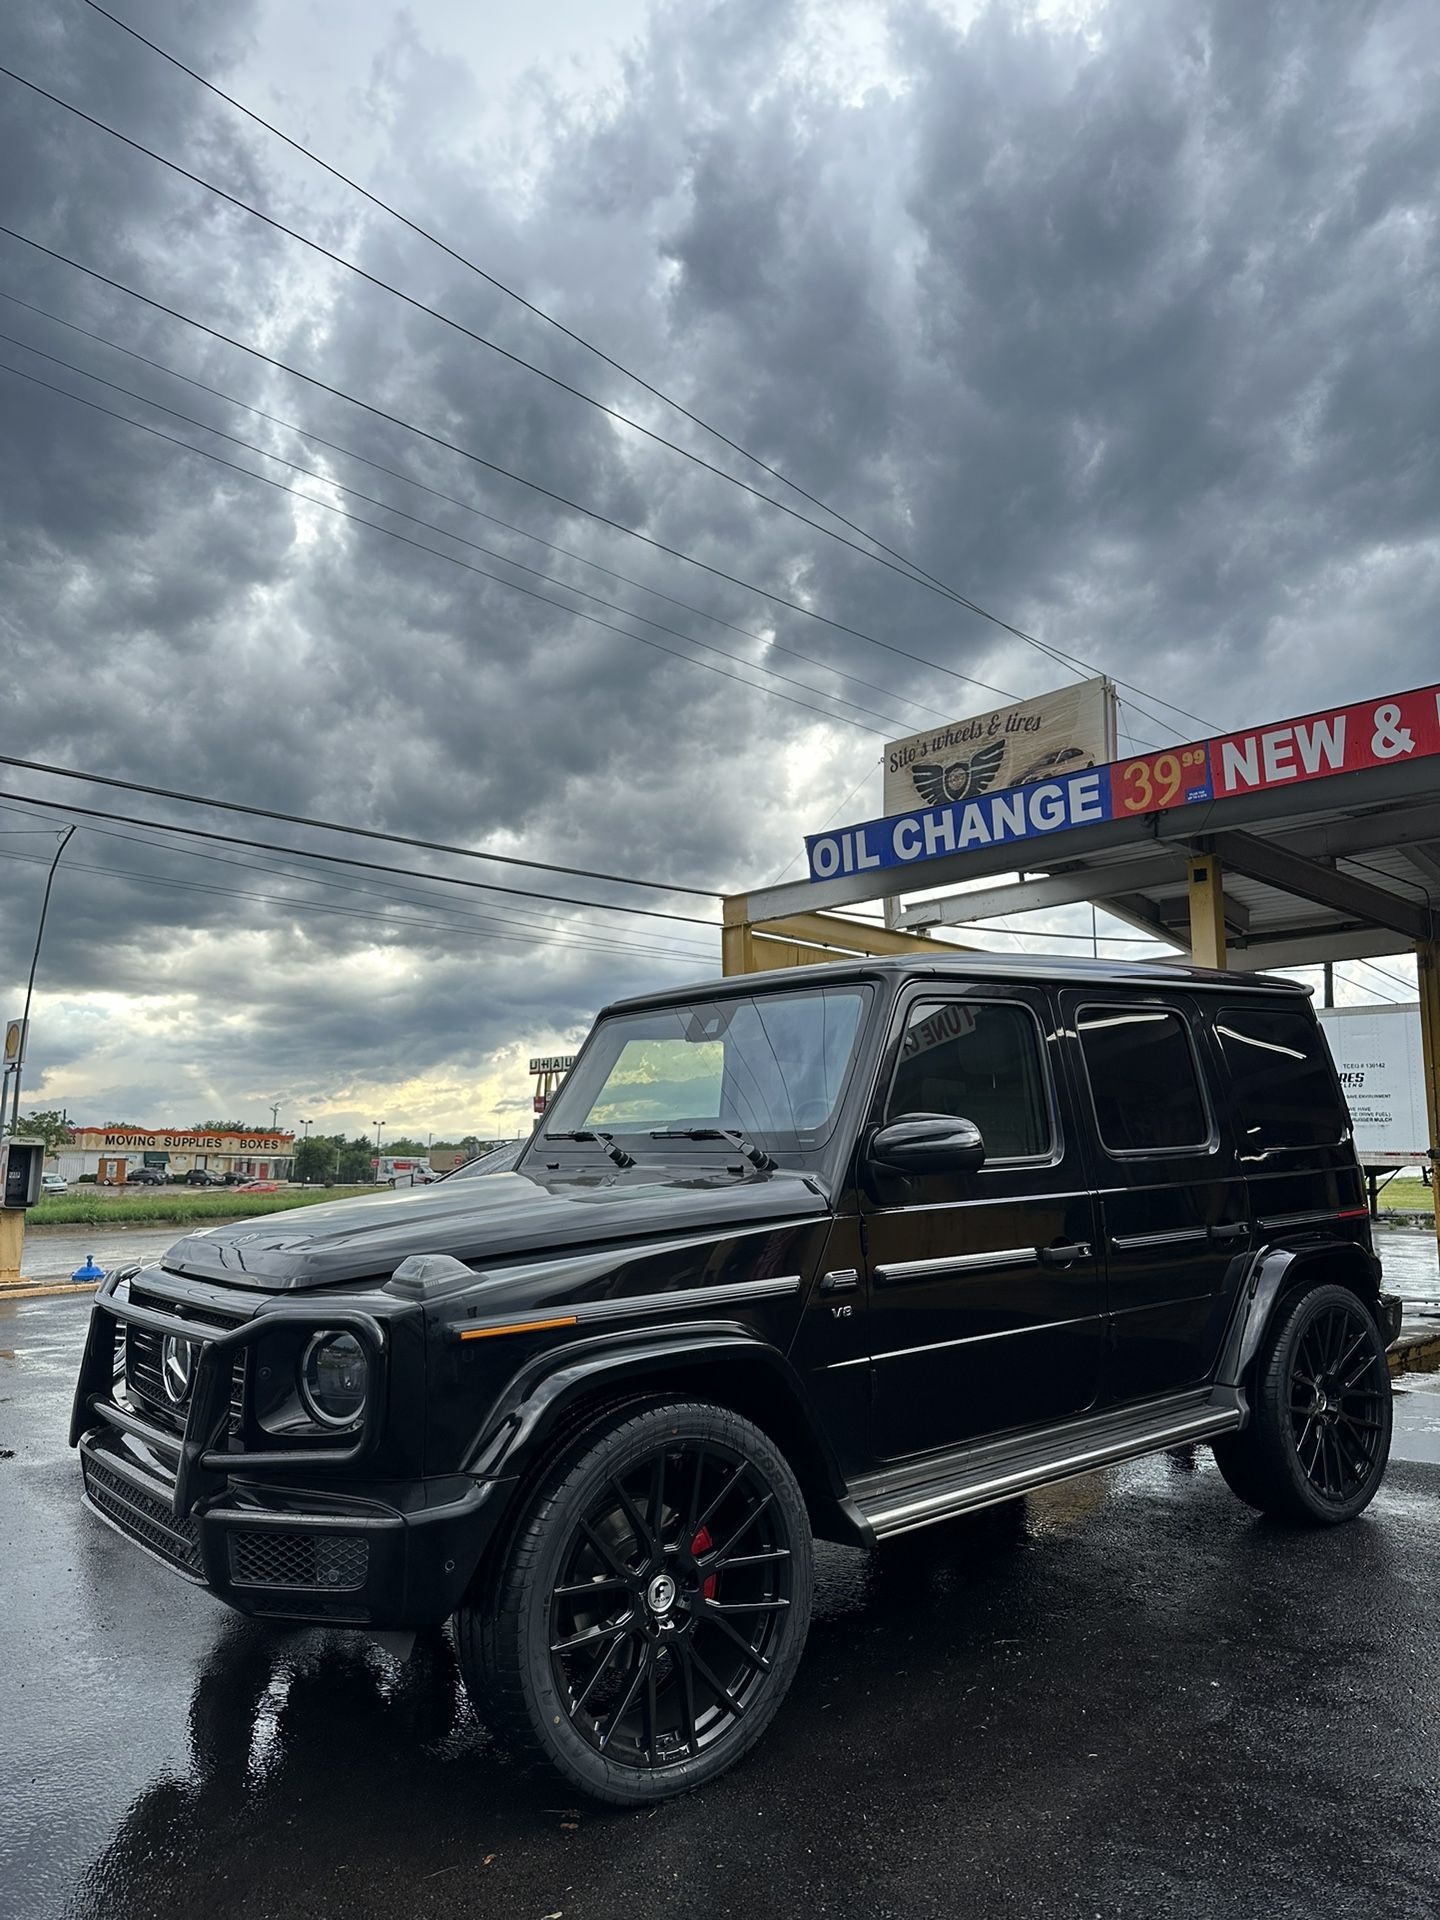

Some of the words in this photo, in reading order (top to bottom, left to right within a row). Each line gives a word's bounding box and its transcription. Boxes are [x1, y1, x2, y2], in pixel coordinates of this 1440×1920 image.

[932, 719, 984, 753] wheels
[987, 714, 1001, 735] &
[1005, 713, 1041, 734] tires
[1222, 715, 1346, 791] NEW
[1371, 704, 1416, 759] &
[812, 830, 880, 877] OIL
[893, 774, 1102, 860] CHANGE
[530, 1057, 572, 1070] UHAU
[1340, 1072, 1365, 1083] RES
[105, 1135, 156, 1146] MOVING
[164, 1136, 222, 1148] SUPPLIES
[240, 1139, 279, 1149] BOXES
[832, 1305, 852, 1318] V8
